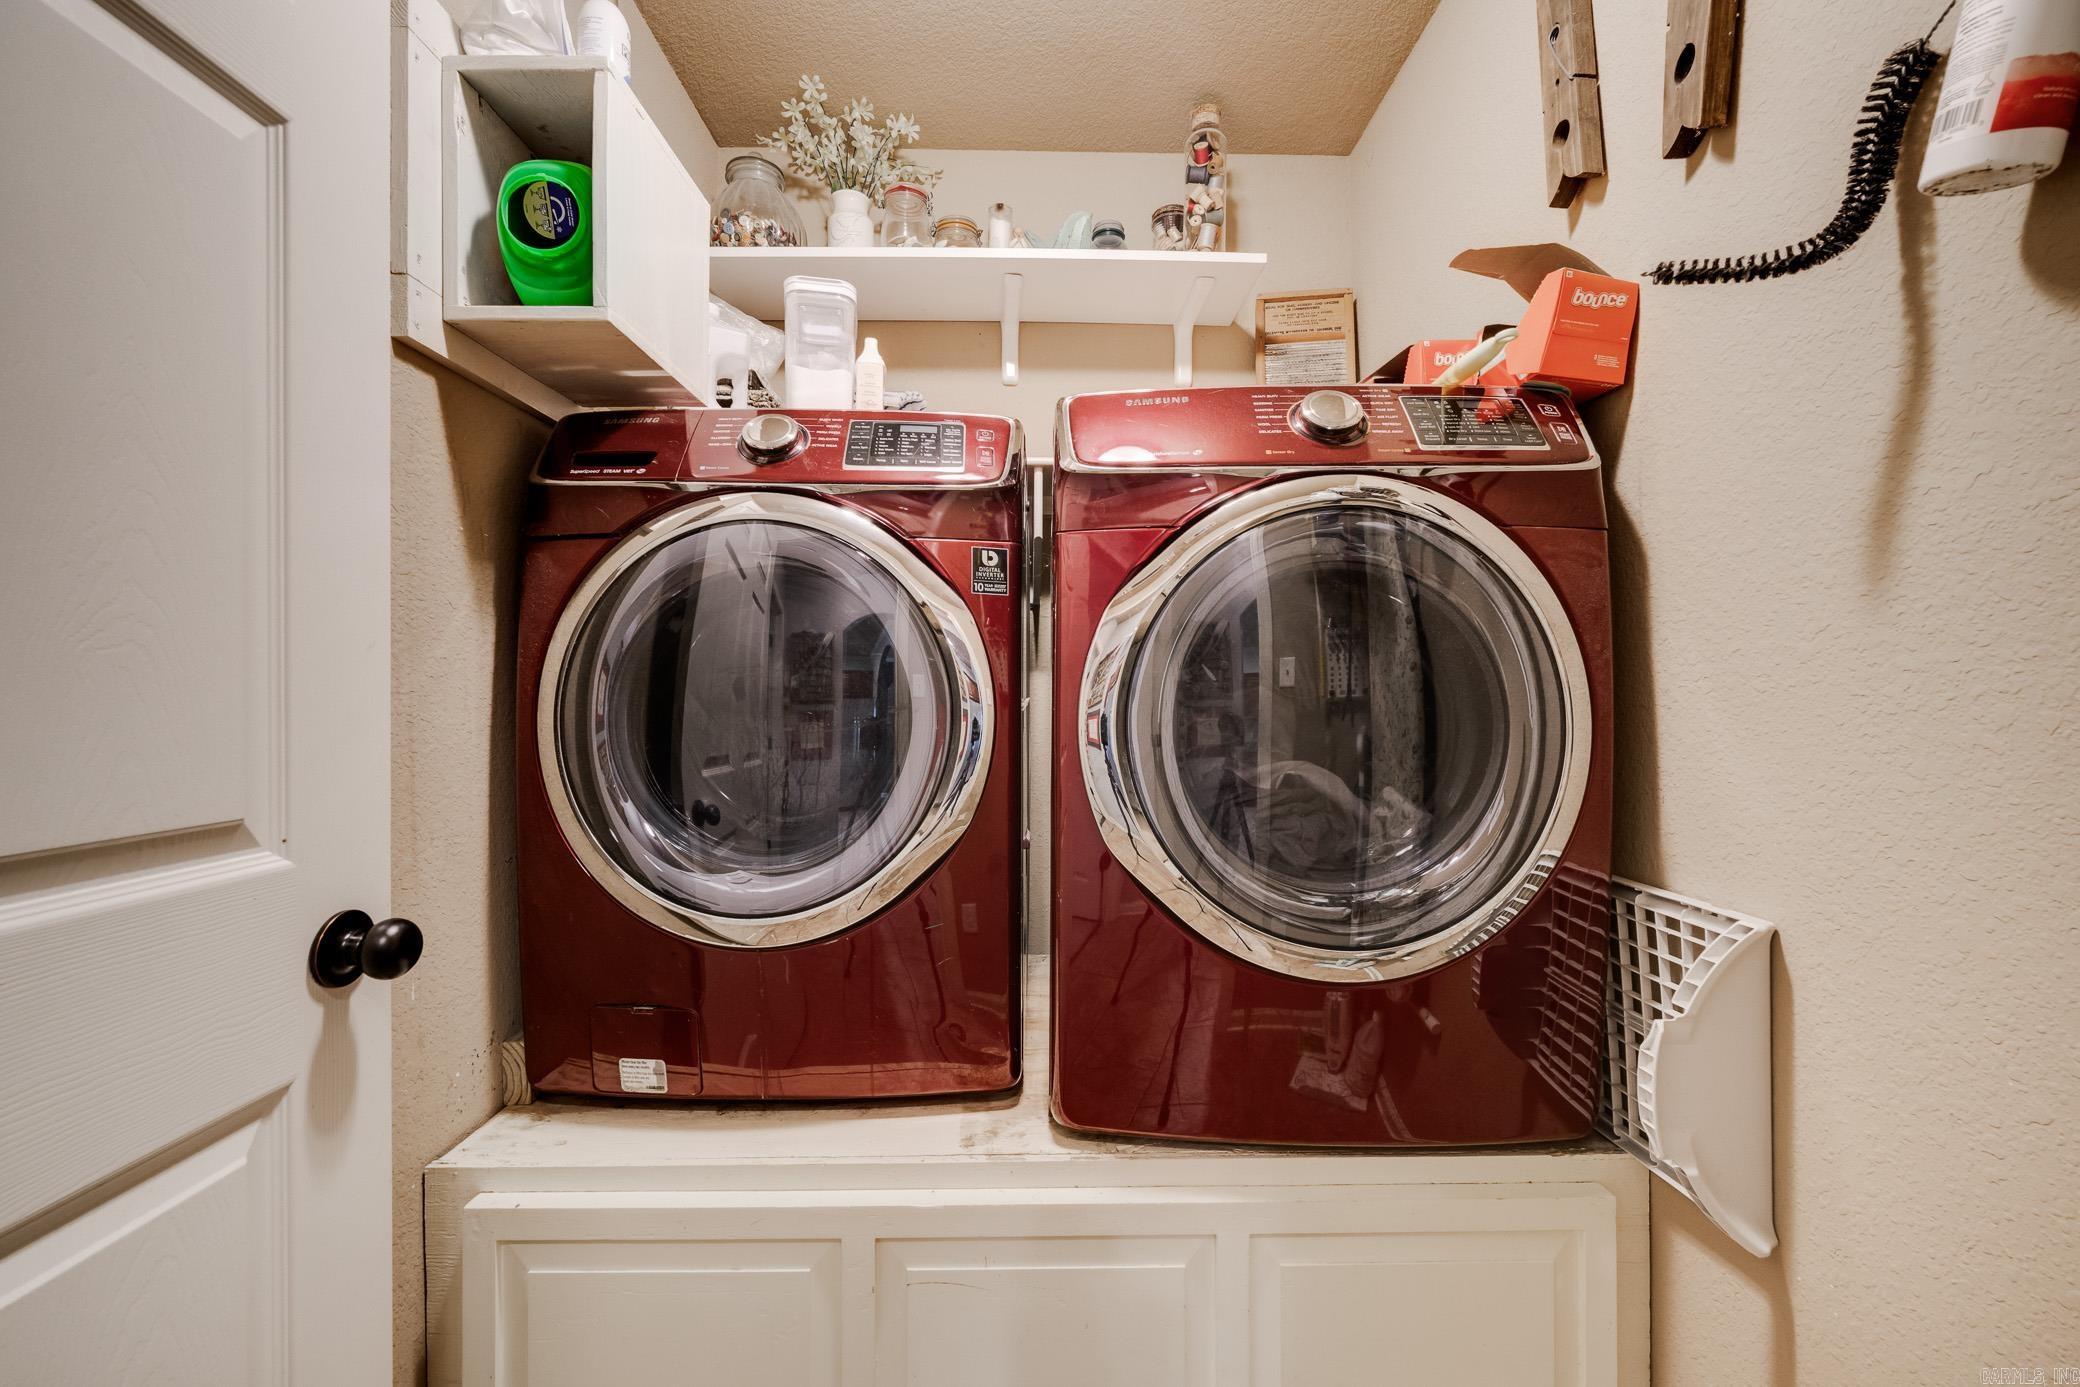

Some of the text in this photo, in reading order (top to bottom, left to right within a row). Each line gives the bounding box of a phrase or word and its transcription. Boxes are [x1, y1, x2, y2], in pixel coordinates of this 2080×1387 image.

[1571, 287, 1628, 309] bounce
[1125, 396, 1190, 407] SAMSUNG
[603, 416, 661, 425] SAMSUNG
[973, 582, 984, 592] 10
